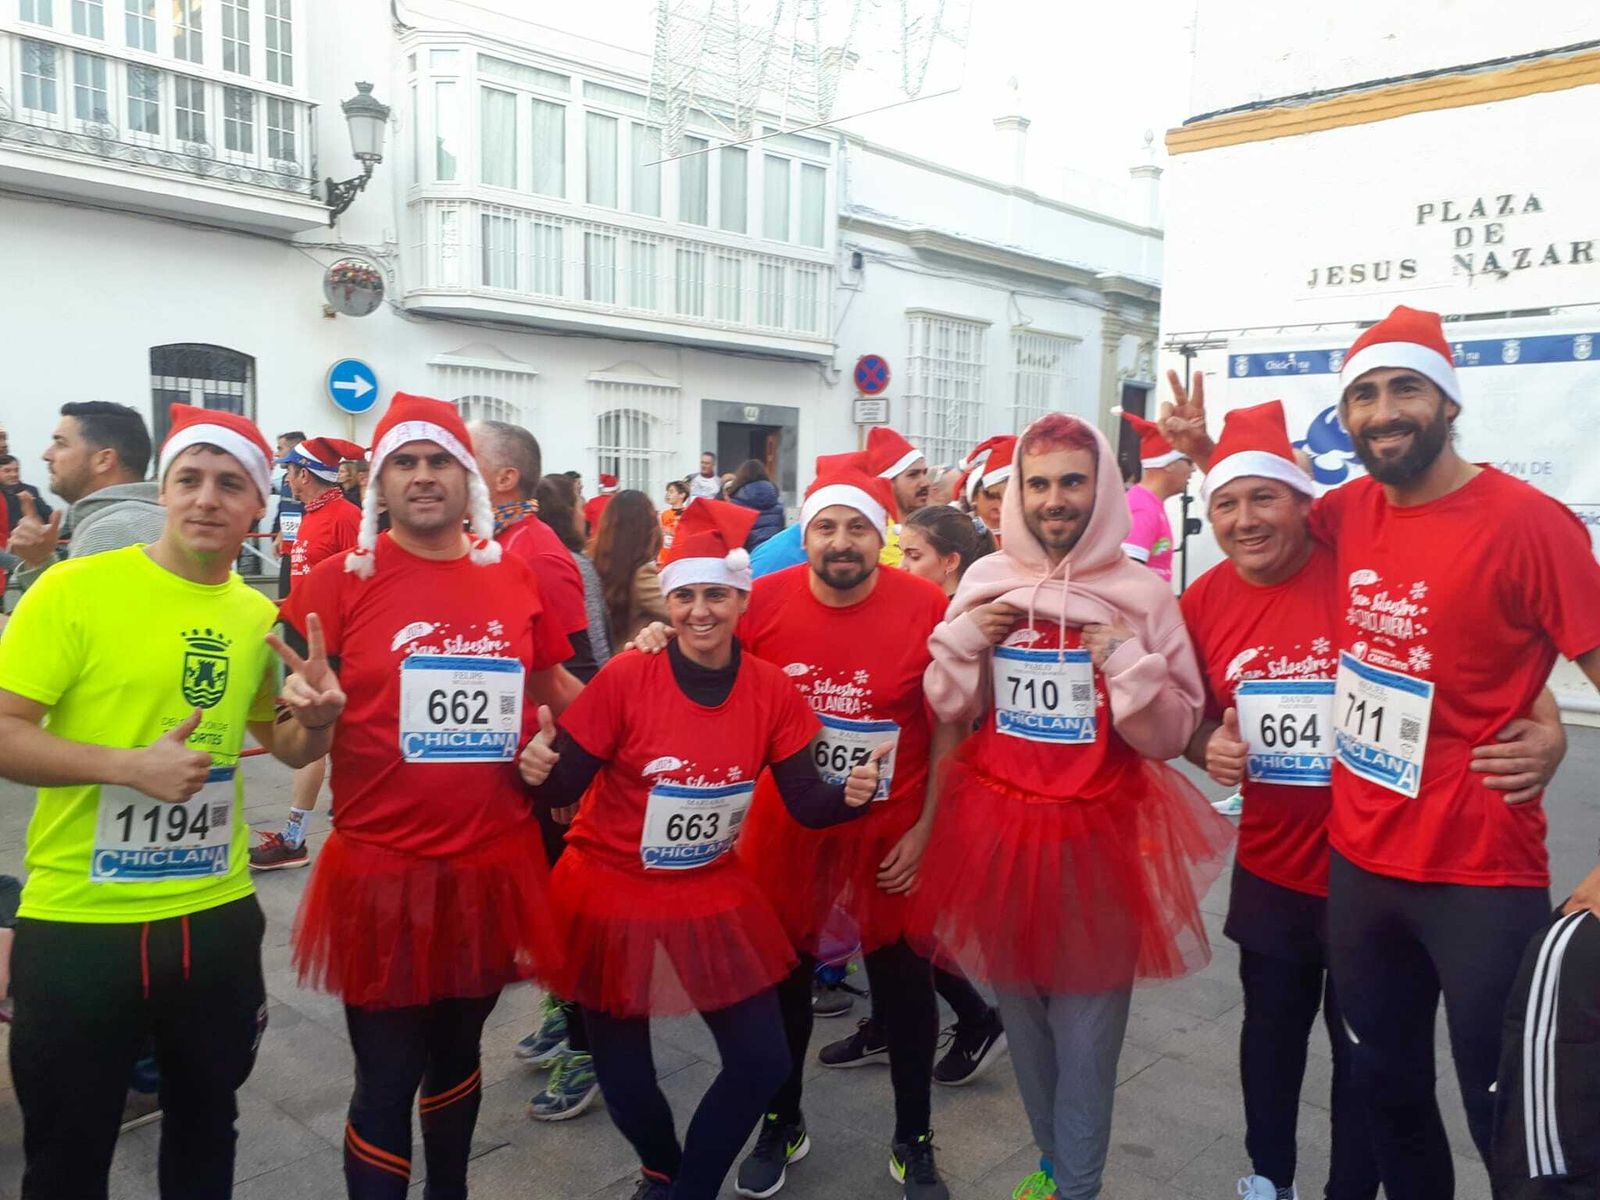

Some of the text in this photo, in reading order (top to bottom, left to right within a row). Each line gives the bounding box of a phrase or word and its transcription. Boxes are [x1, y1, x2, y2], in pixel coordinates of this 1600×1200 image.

[1416, 193, 1544, 225] PLAZA
[1453, 222, 1505, 249] DE
[1307, 258, 1418, 289] JESUS
[428, 689, 489, 725] 662
[1007, 676, 1059, 711] 710
[996, 710, 1096, 739] CHICLANA
[1260, 713, 1321, 748] 664
[1348, 692, 1384, 742] 711
[403, 732, 516, 758] CHICLANA
[815, 741, 867, 772] 665
[116, 803, 210, 843] 1194
[666, 812, 720, 841] 663
[95, 846, 229, 877] CHICLANA
